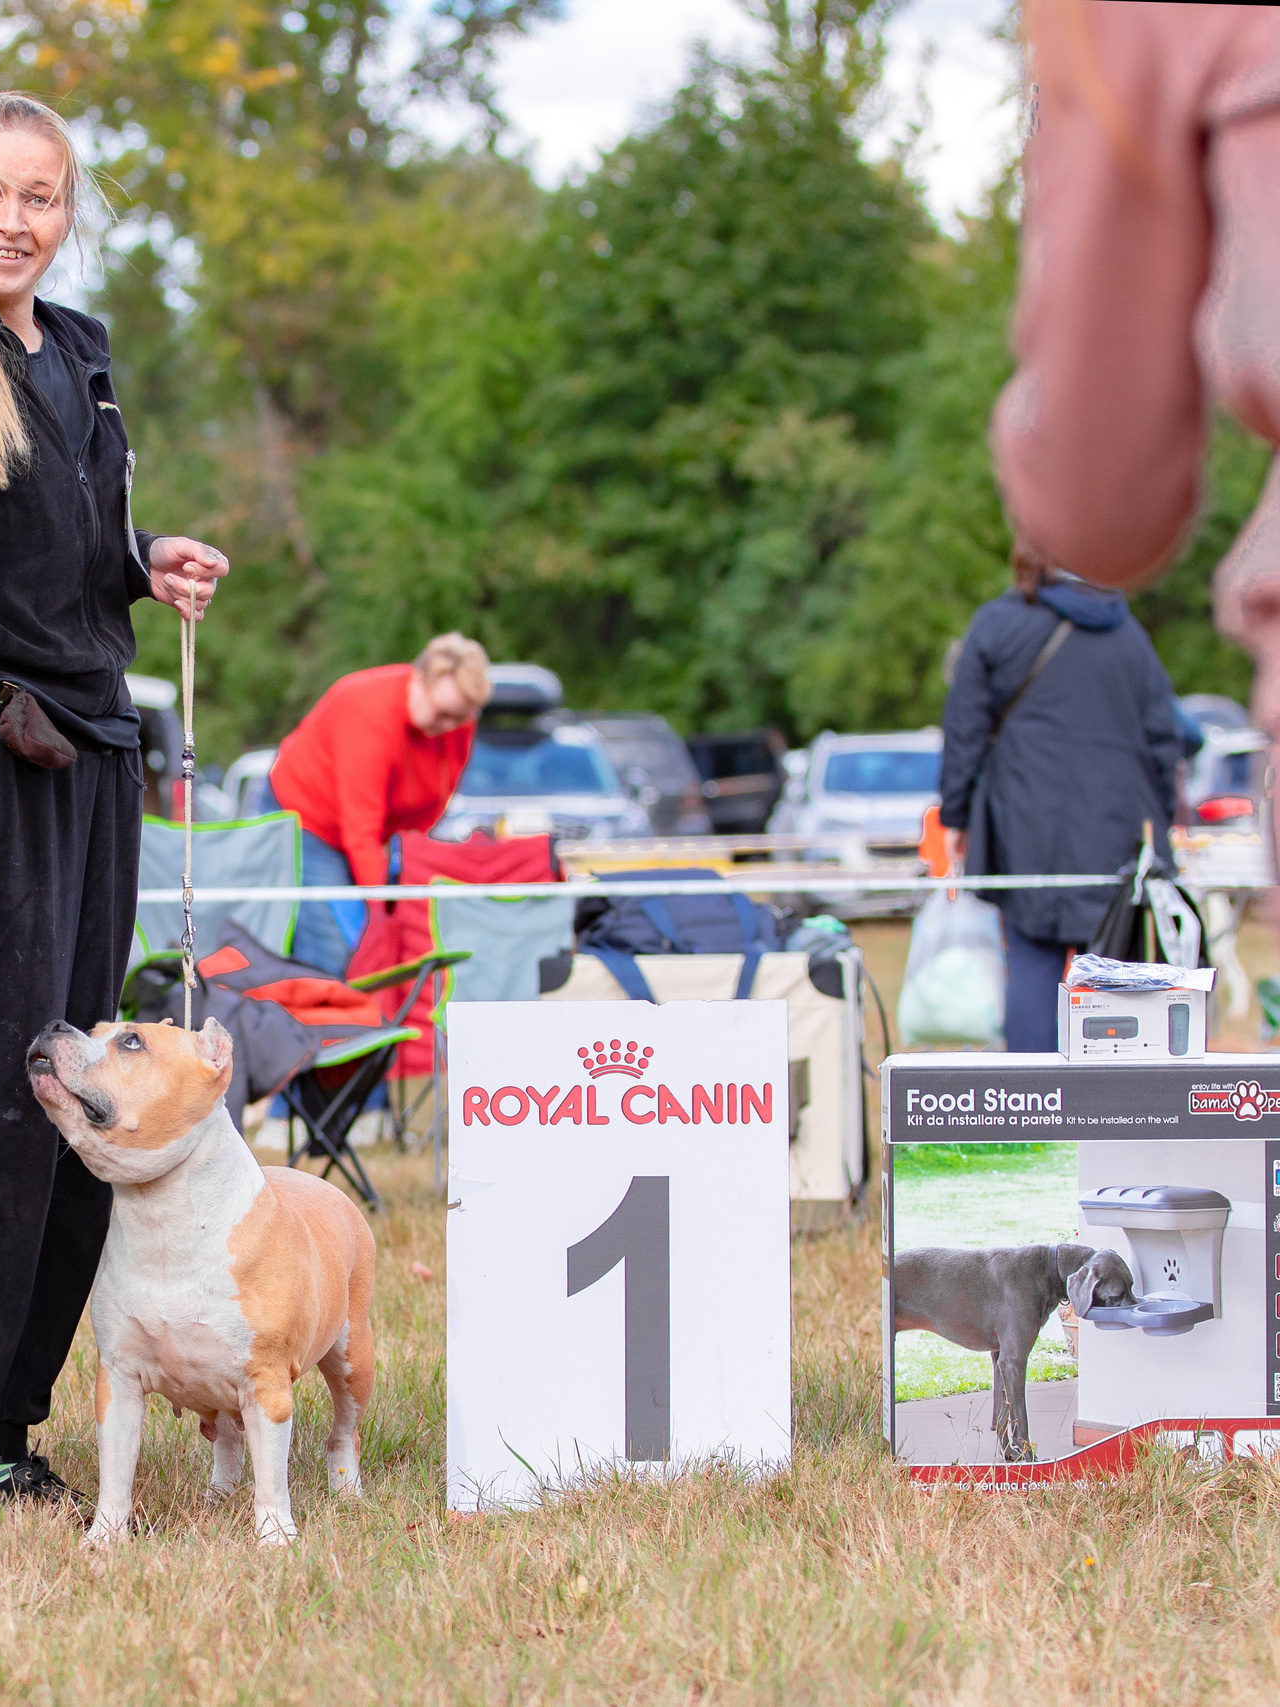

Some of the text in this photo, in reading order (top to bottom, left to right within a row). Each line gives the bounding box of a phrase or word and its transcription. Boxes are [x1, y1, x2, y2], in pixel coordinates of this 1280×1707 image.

[1191, 1082, 1236, 1091] enjoy life with
[462, 1082, 773, 1126] ROYAL CANIN
[906, 1088, 975, 1112] Food
[983, 1087, 1062, 1112] Stand
[1191, 1093, 1229, 1110] bama
[907, 1113, 1179, 1128] Kit da installare a parete Kit to be installed on the wall
[566, 1175, 670, 1462] 1
